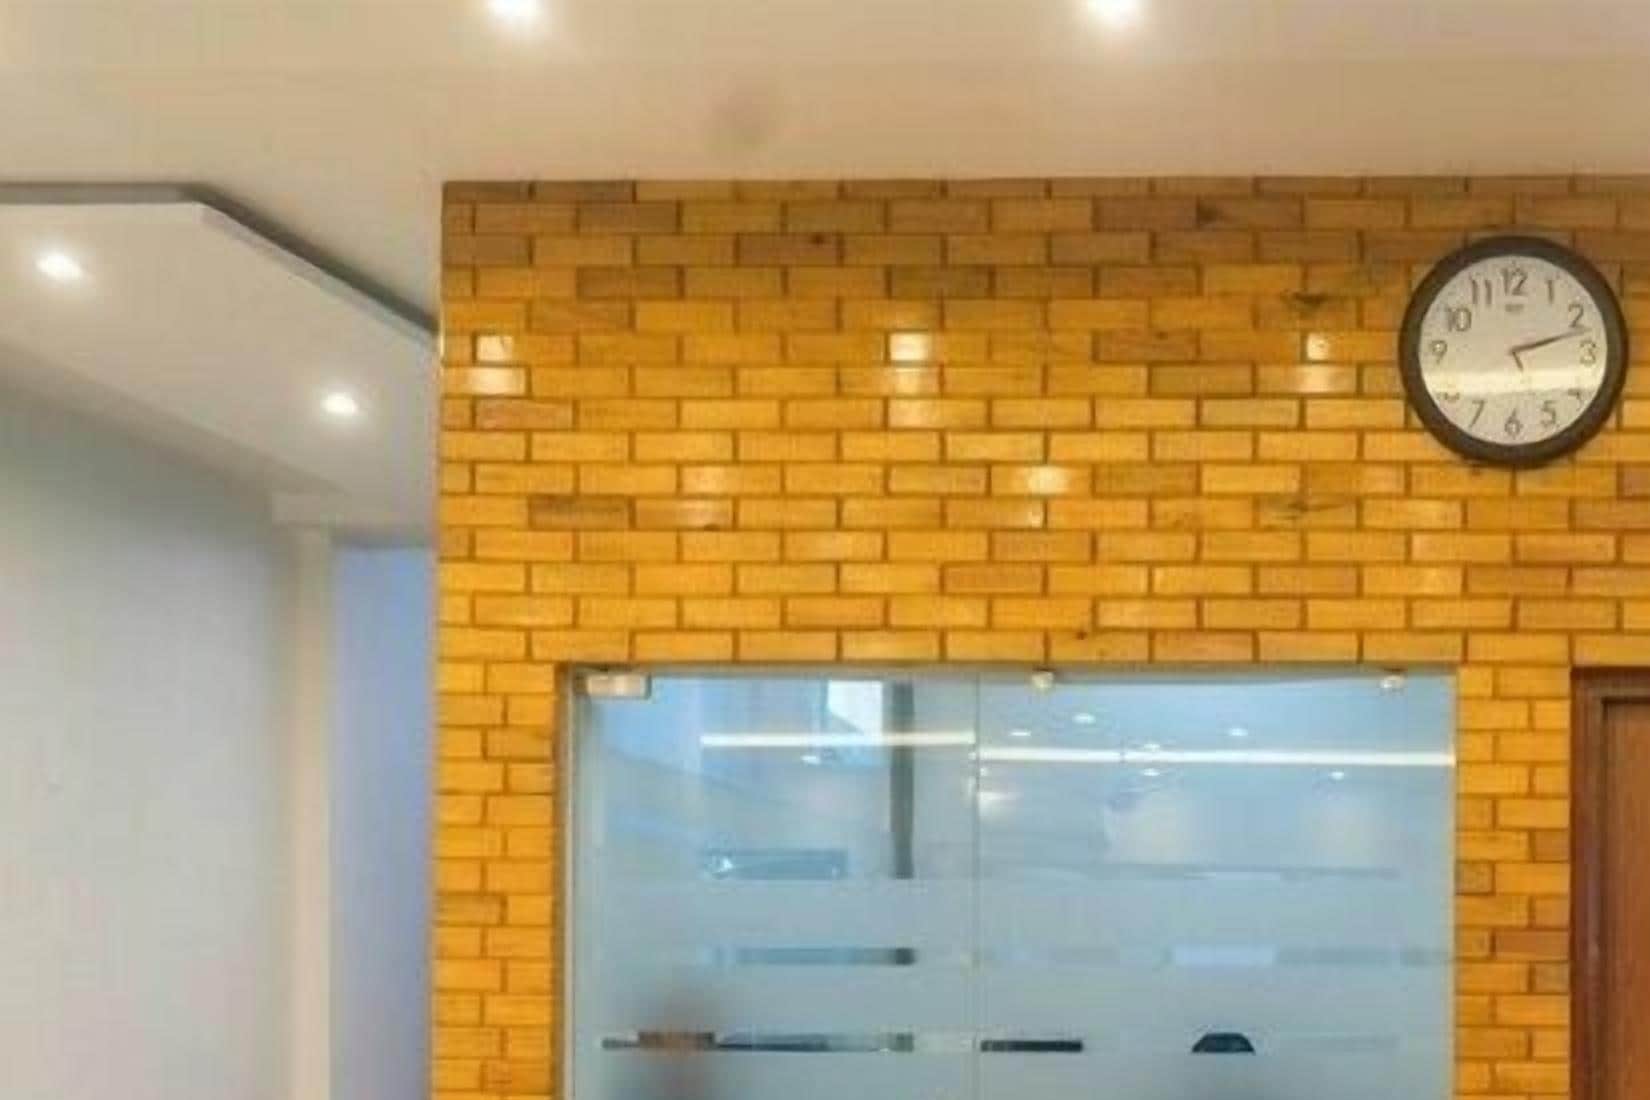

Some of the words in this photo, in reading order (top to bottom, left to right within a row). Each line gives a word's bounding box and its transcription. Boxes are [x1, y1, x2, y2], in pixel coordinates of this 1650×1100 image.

[1470, 276, 1493, 307] 11
[1502, 267, 1528, 296] 12
[1445, 306, 1473, 332] 10
[1567, 302, 1585, 328] 2
[1430, 339, 1448, 365] 9
[1579, 339, 1597, 365] 3
[1470, 399, 1487, 429] 7
[1504, 408, 1522, 438] 6
[1541, 400, 1557, 428] 5
